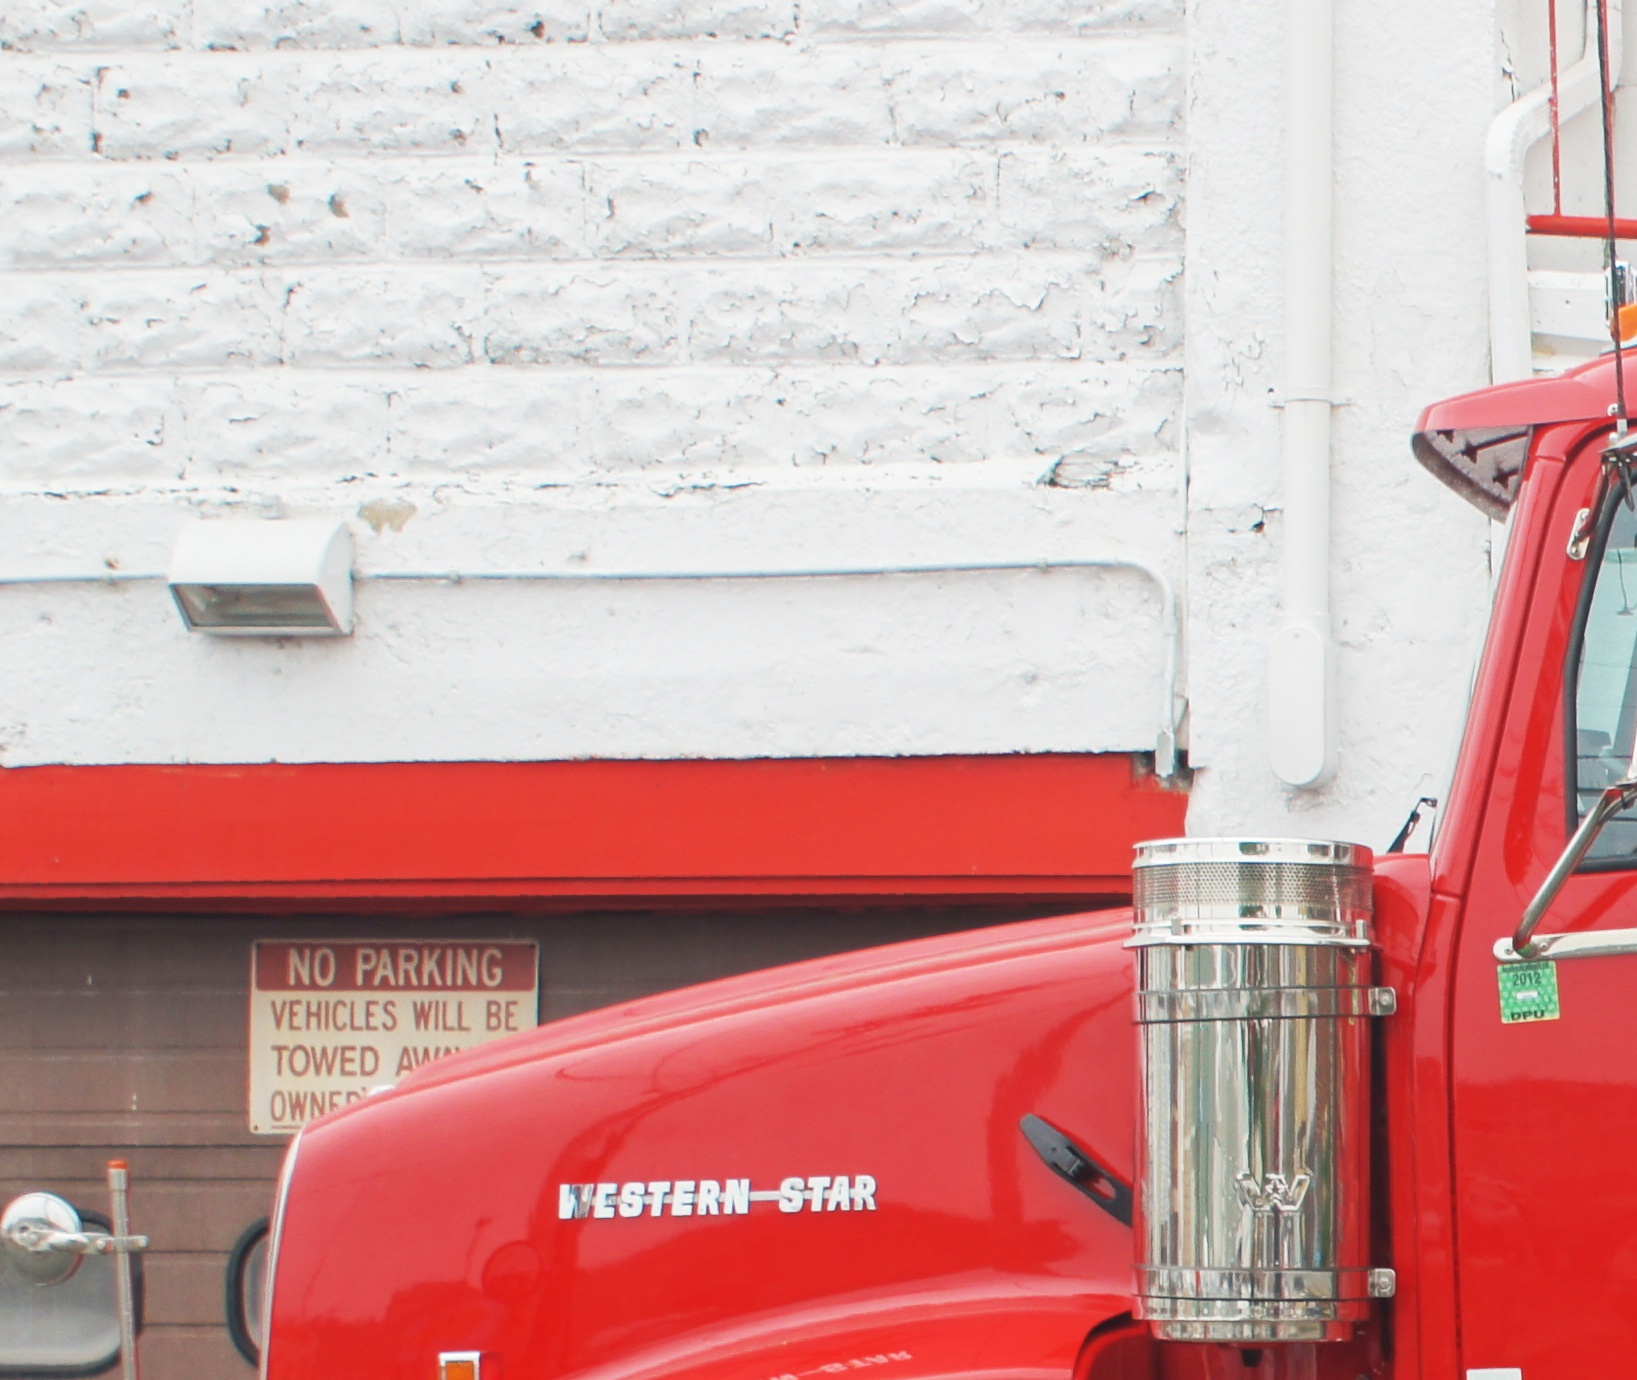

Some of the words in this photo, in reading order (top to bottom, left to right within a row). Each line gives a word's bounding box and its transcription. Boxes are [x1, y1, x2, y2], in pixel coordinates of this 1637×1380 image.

[287, 948, 336, 986] NO
[356, 948, 503, 987] PARKING
[1512, 972, 1541, 987] 2012
[270, 1000, 398, 1031] VEHICLES
[412, 1000, 471, 1031] WILL
[486, 1000, 519, 1031] BE
[1511, 1009, 1545, 1021] DPU
[270, 1044, 380, 1077] TOWED
[558, 1178, 751, 1220] WESTERN
[778, 1175, 877, 1214] STAR
